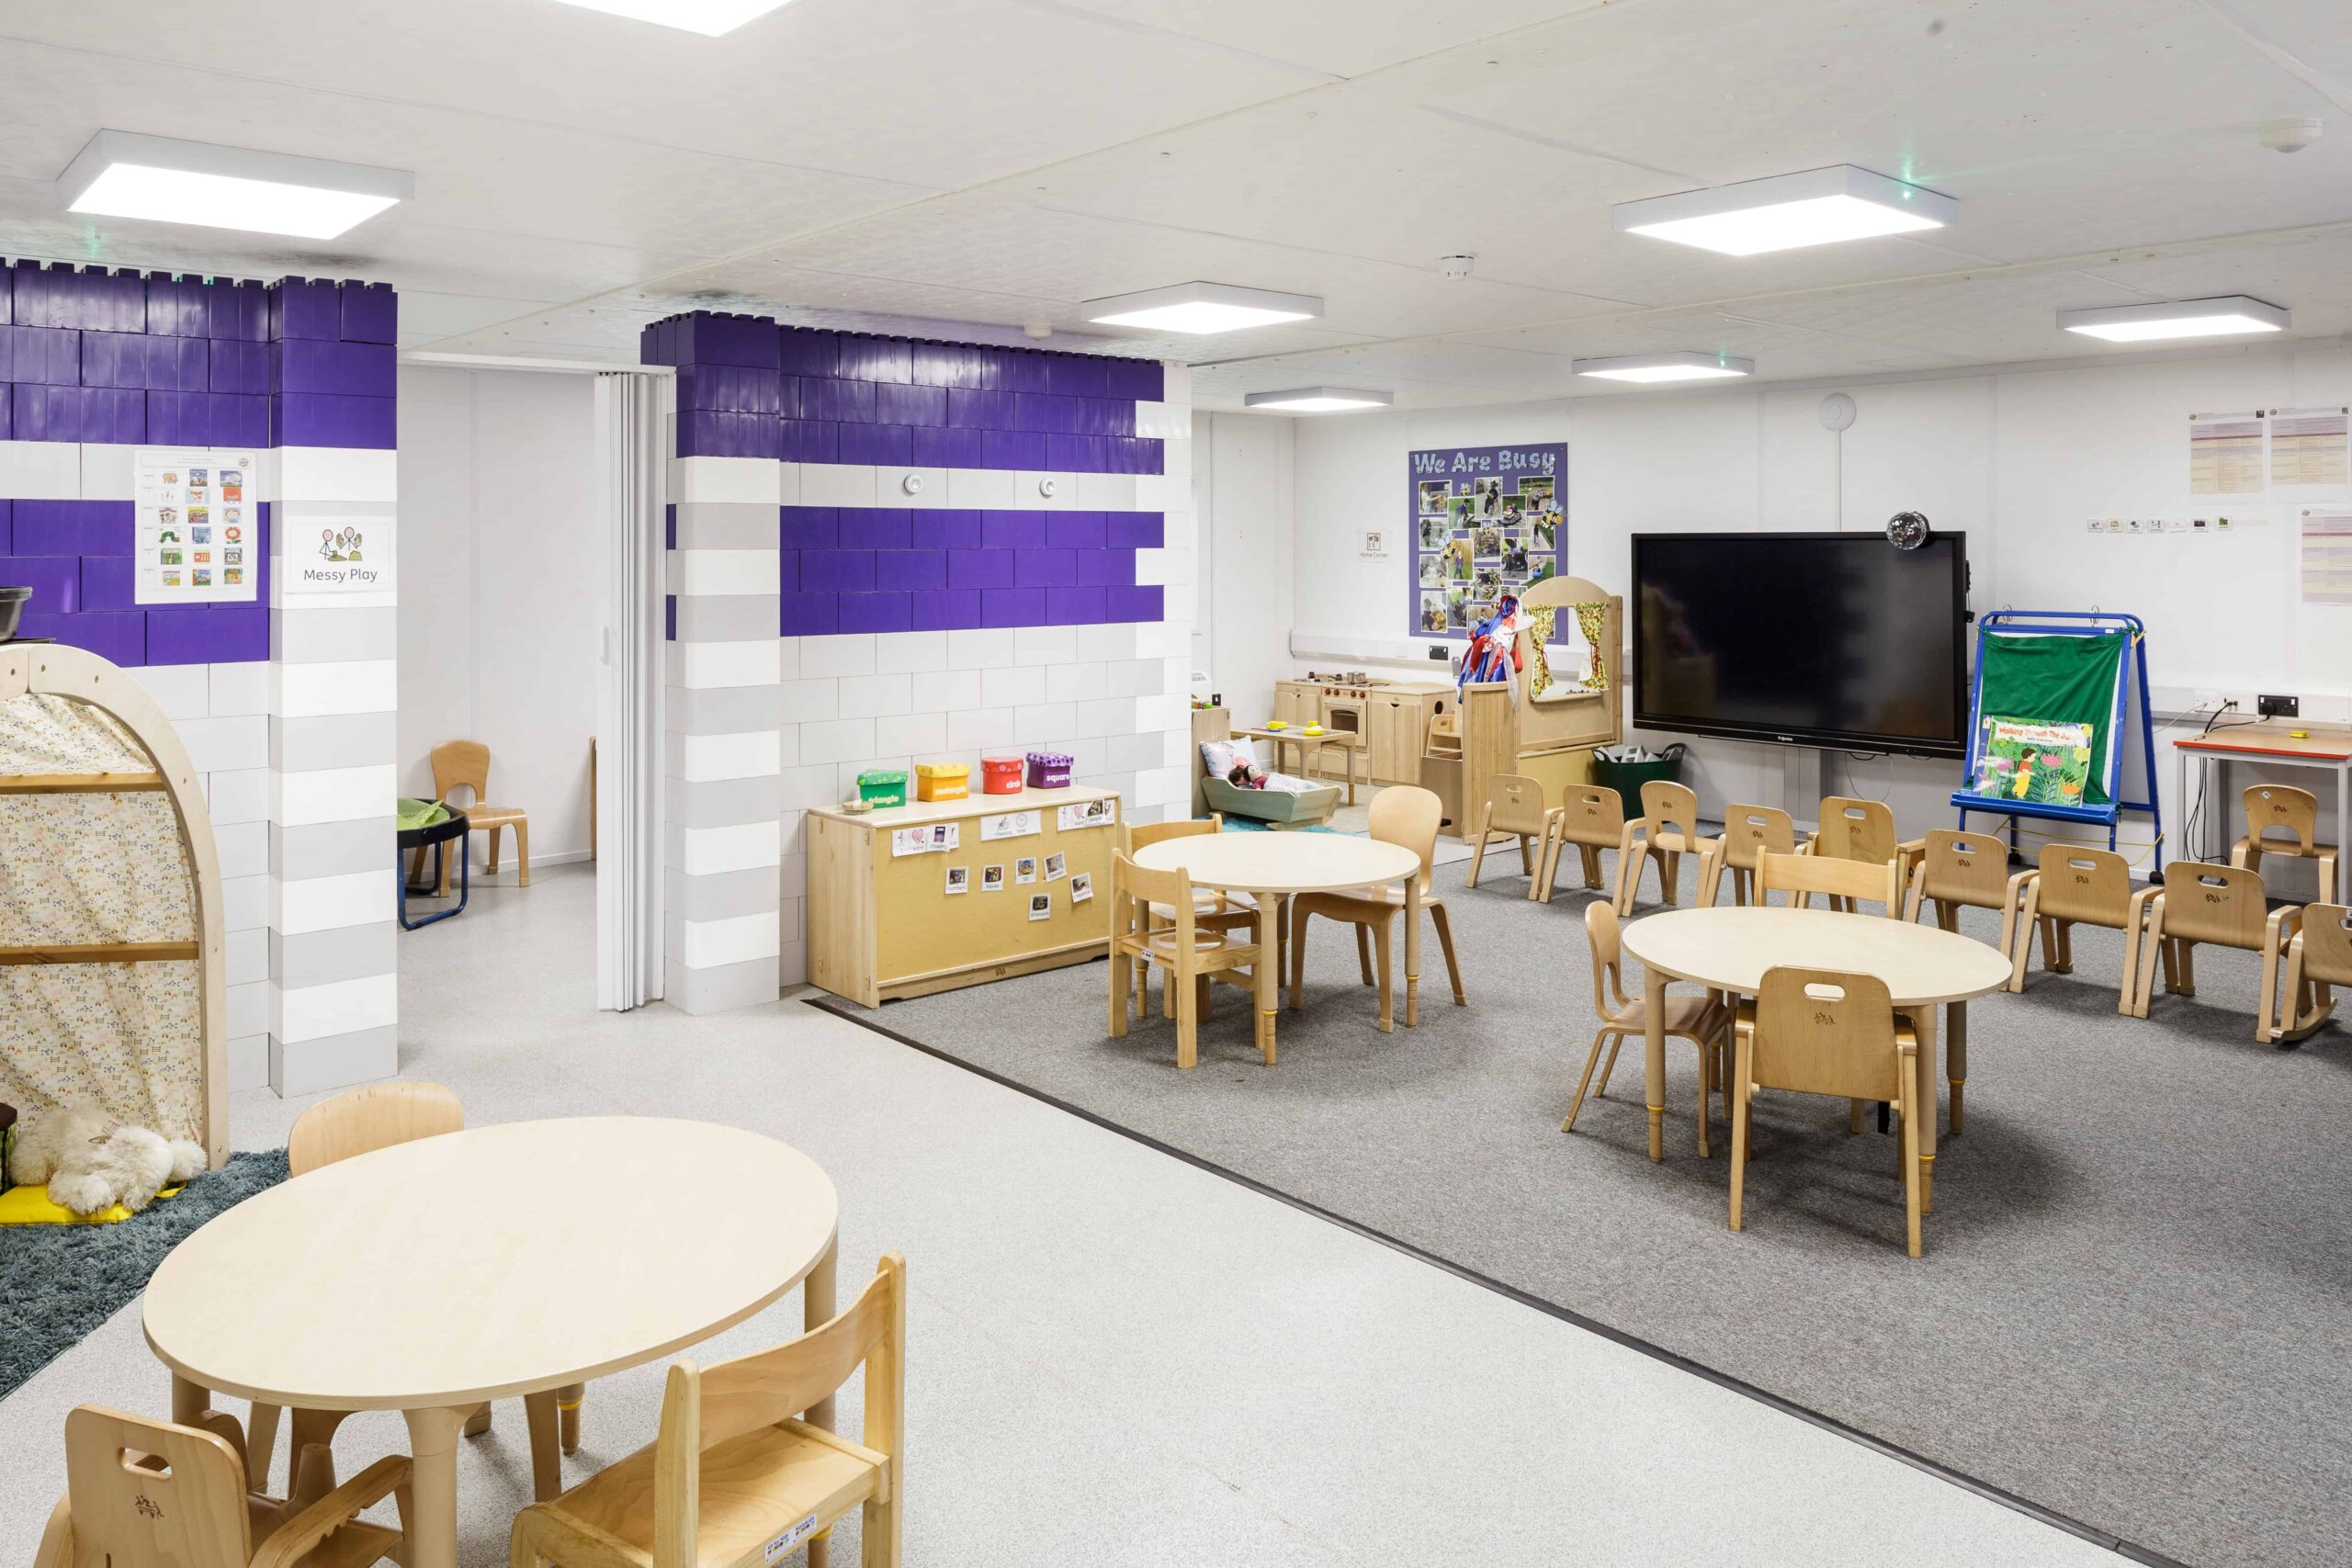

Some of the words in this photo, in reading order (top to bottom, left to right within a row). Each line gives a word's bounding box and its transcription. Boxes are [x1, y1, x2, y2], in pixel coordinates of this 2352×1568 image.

[1414, 453, 1446, 474] We
[1452, 452, 1491, 473] Are
[1498, 450, 1555, 476] Busy
[303, 569, 346, 583] Messy
[350, 568, 378, 583] Play
[1998, 727, 2023, 737] Walking
[935, 784, 967, 796] rectangle
[868, 794, 899, 805] triangle
